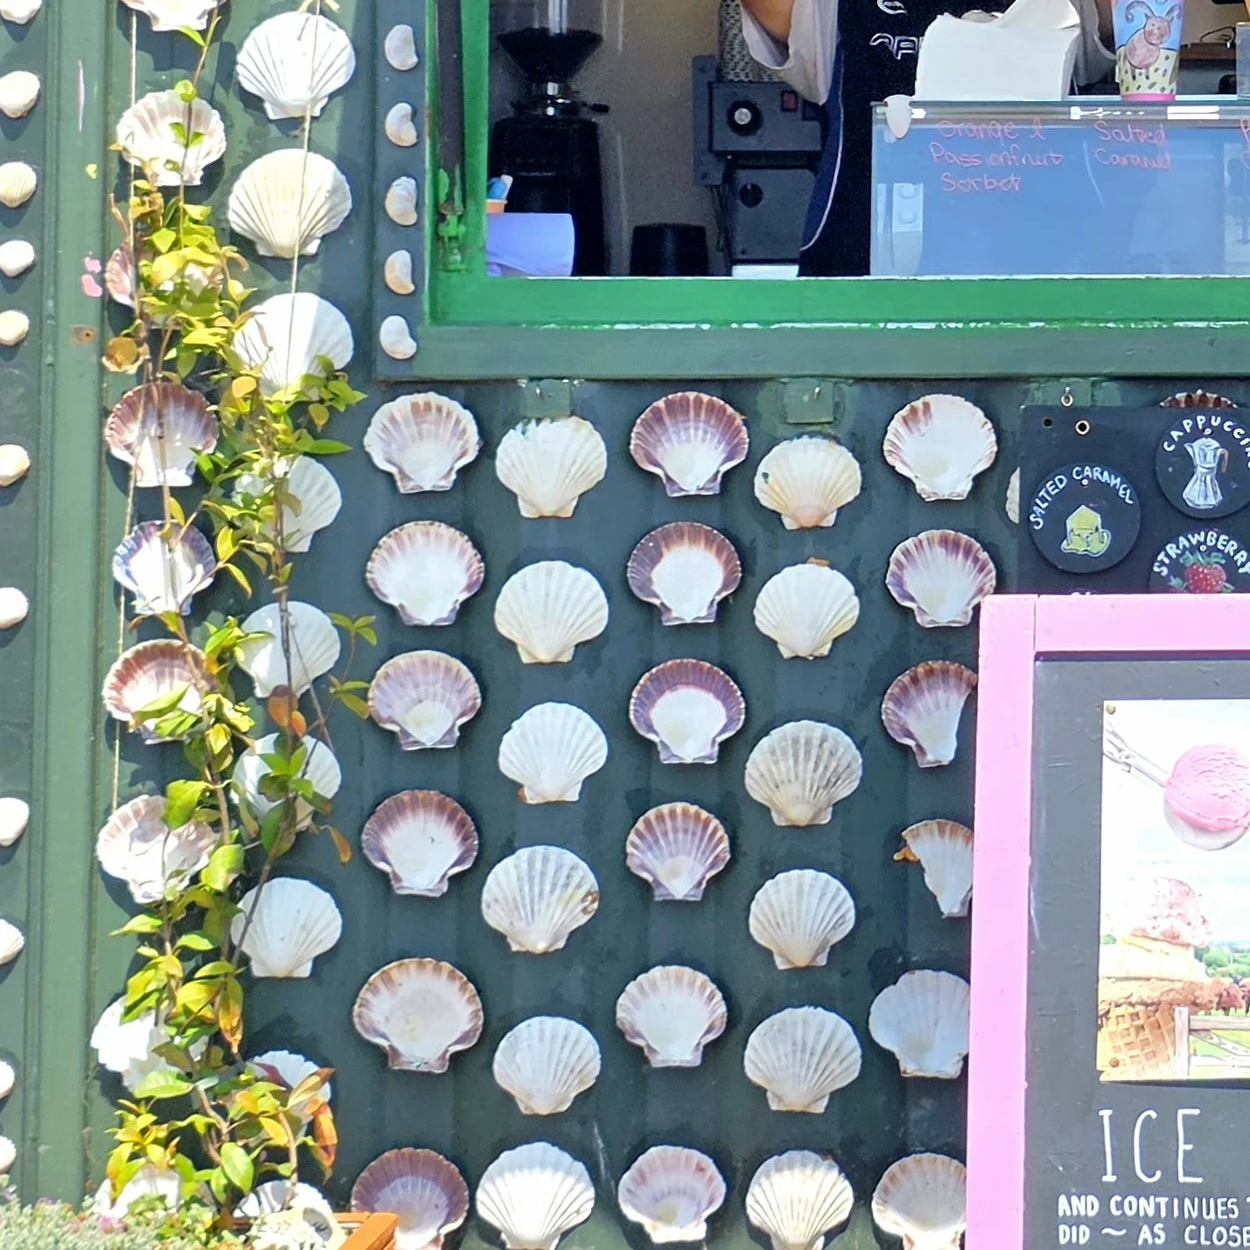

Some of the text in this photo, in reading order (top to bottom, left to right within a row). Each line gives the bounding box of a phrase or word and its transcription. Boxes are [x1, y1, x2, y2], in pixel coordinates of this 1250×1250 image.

[938, 119, 1019, 147] Orange
[1093, 121, 1167, 145] Salted
[1029, 465, 1135, 530] SALTED CARAMEL
[1098, 1108, 1204, 1183] ICE
[1057, 1195, 1099, 1217] AND
[1109, 1195, 1239, 1220] CONTINUES
[1058, 1224, 1090, 1245] DID
[1137, 1223, 1166, 1246] AS
